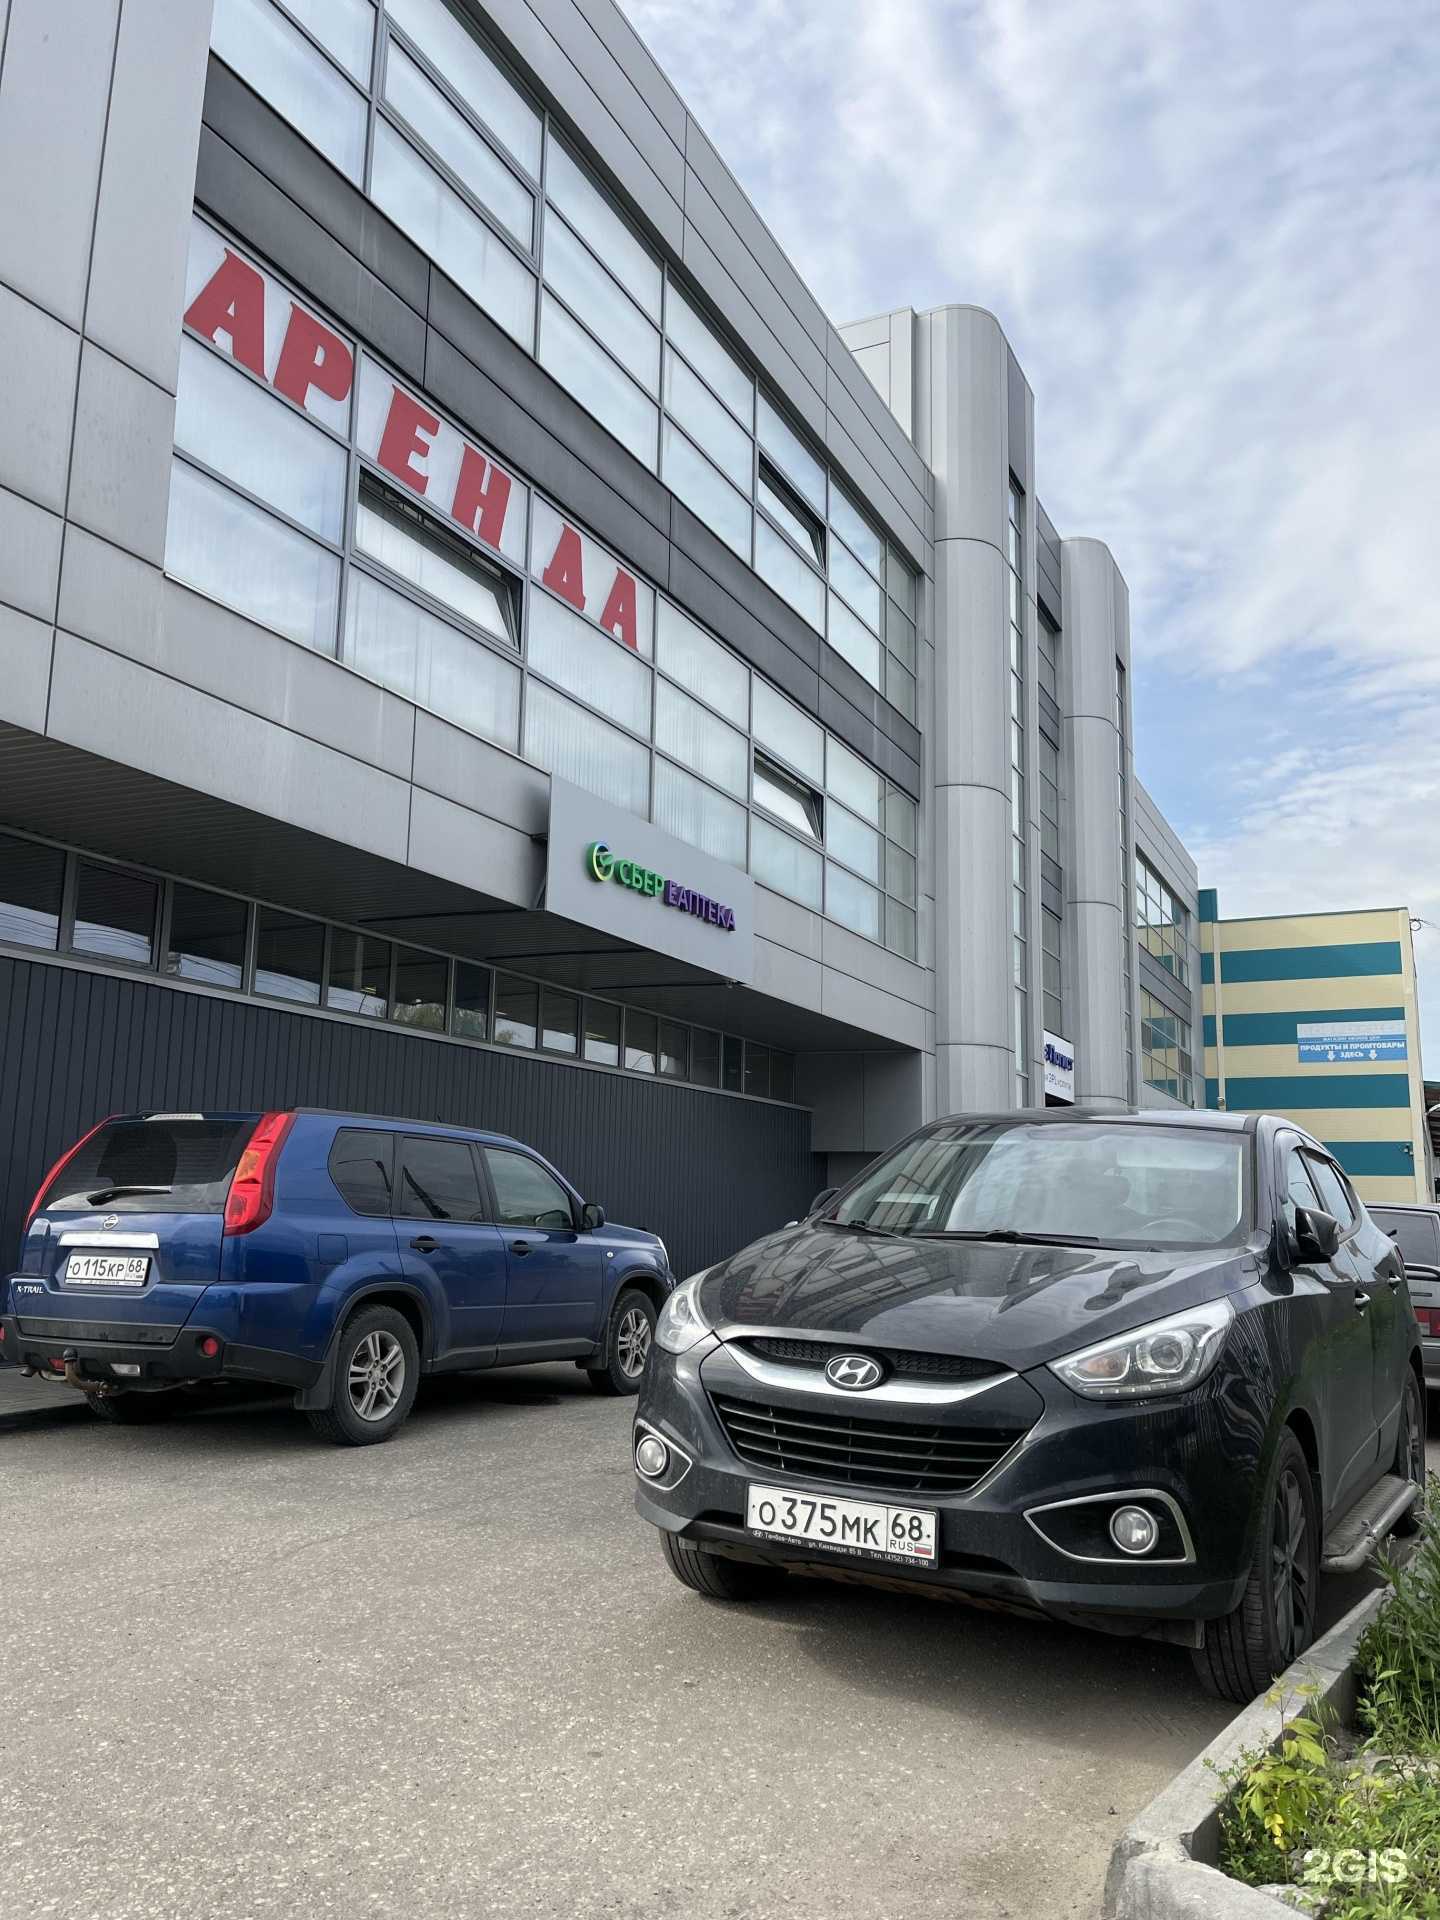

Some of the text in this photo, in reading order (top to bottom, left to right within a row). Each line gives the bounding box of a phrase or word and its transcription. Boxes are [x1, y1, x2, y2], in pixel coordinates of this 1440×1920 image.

[183, 247, 639, 652] АРЕНДА
[615, 858, 736, 931] СБЕР ЕАПТЕКА
[1300, 1043, 1341, 1052] ПРОДУКТЫ
[1340, 1051, 1364, 1059] ЗДЕСЬ
[72, 1258, 143, 1277] О115КР 68
[16, 1285, 44, 1294] X-TRAIL
[758, 1496, 923, 1546] О375МК 68
[889, 1539, 914, 1553] RUS
